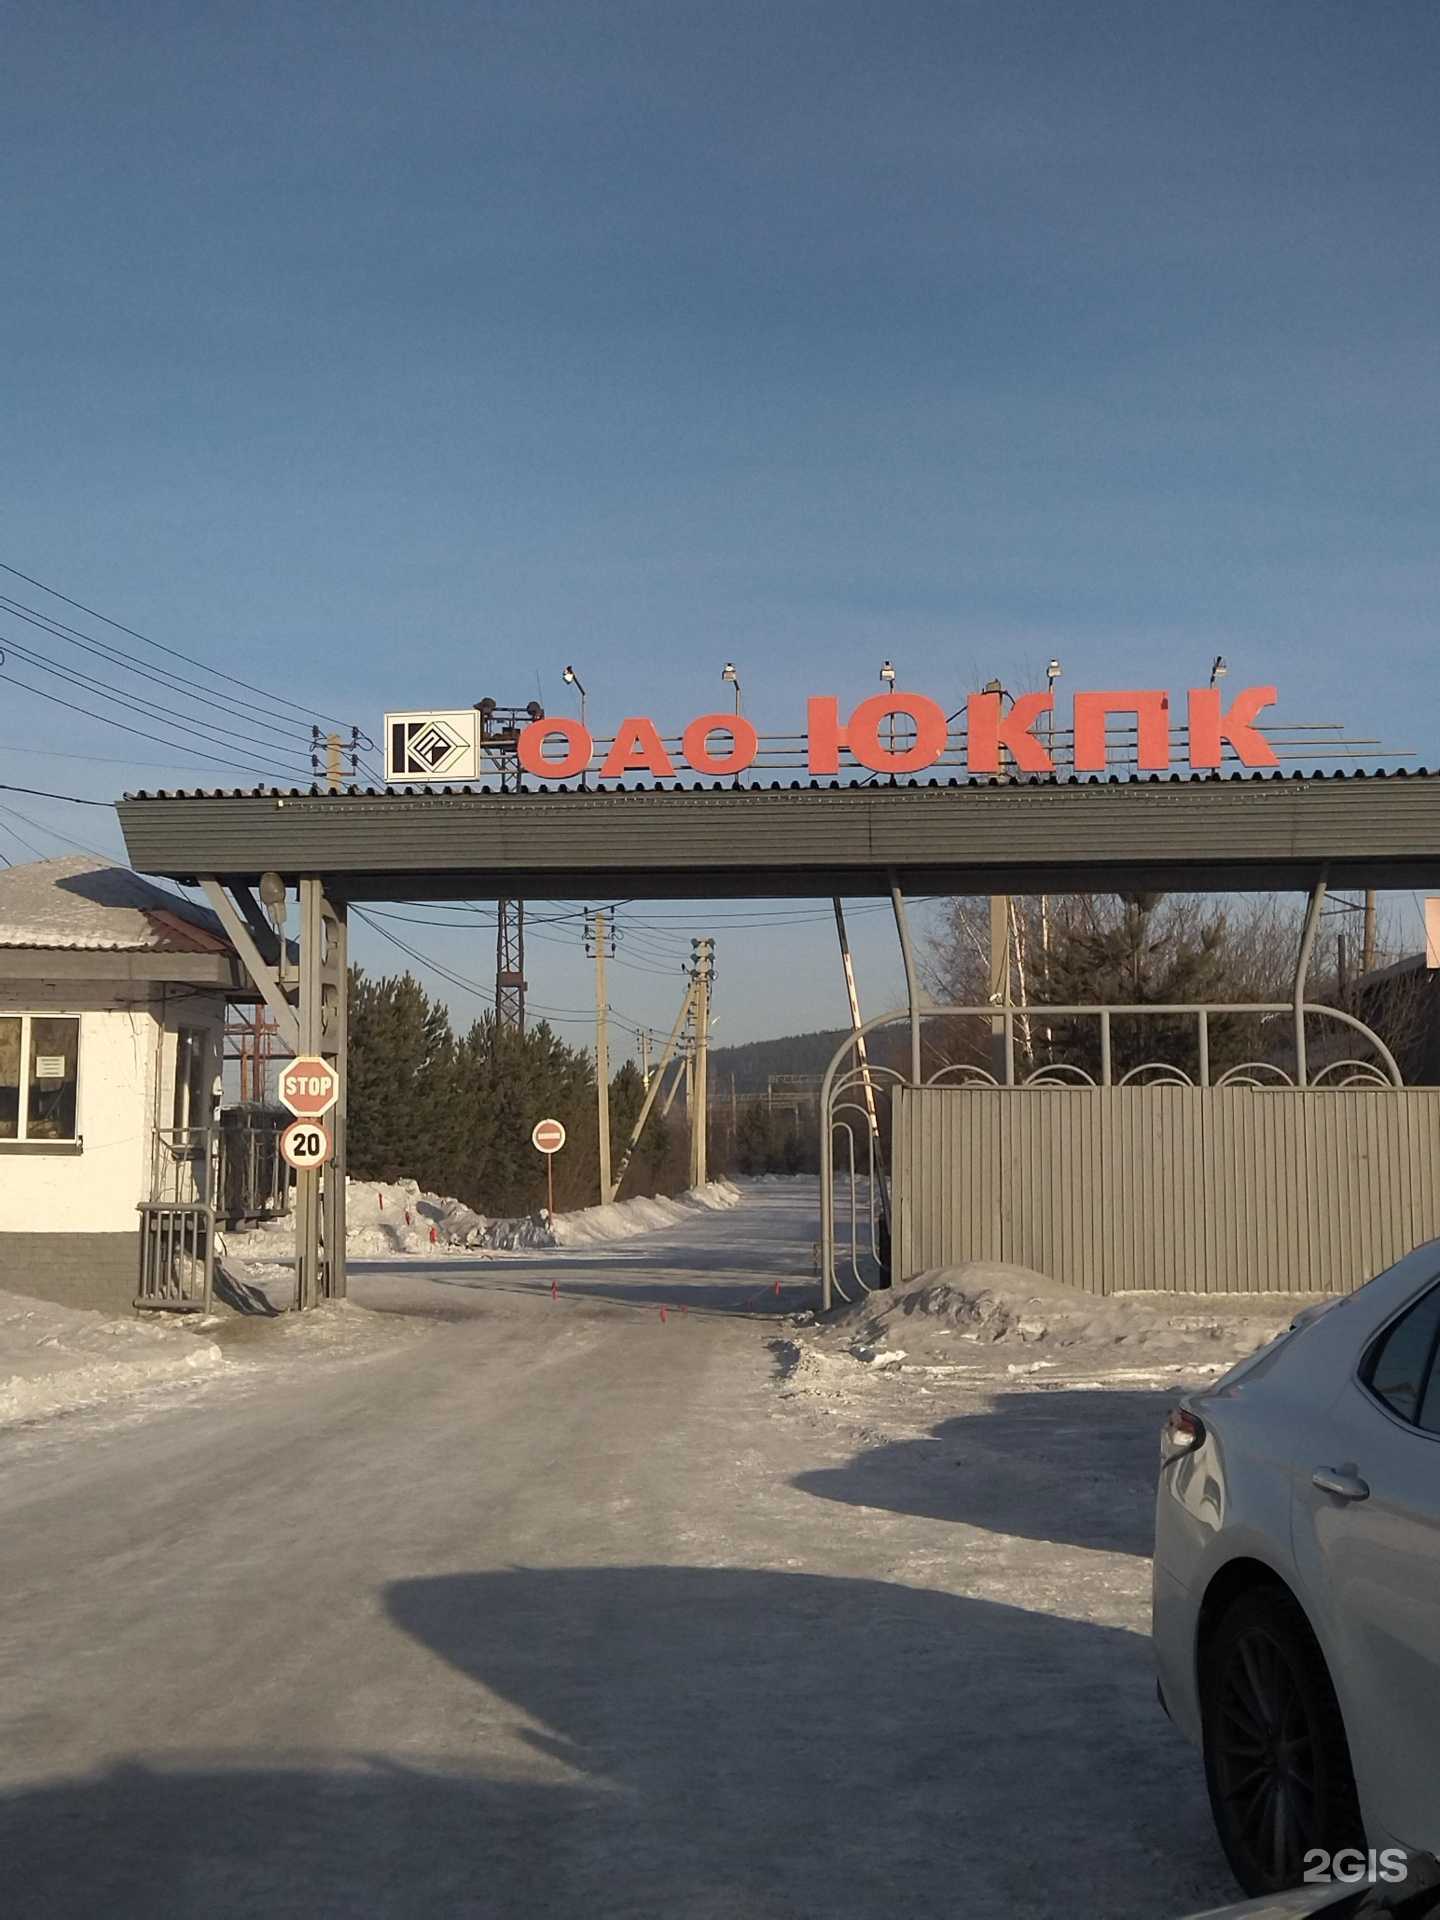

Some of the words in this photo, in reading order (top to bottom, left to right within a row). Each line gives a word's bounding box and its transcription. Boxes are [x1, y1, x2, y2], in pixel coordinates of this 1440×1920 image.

[517, 714, 758, 778] ОАО
[807, 686, 1281, 776] ЮКПК
[286, 1077, 332, 1096] STOP
[293, 1133, 320, 1156] 20
